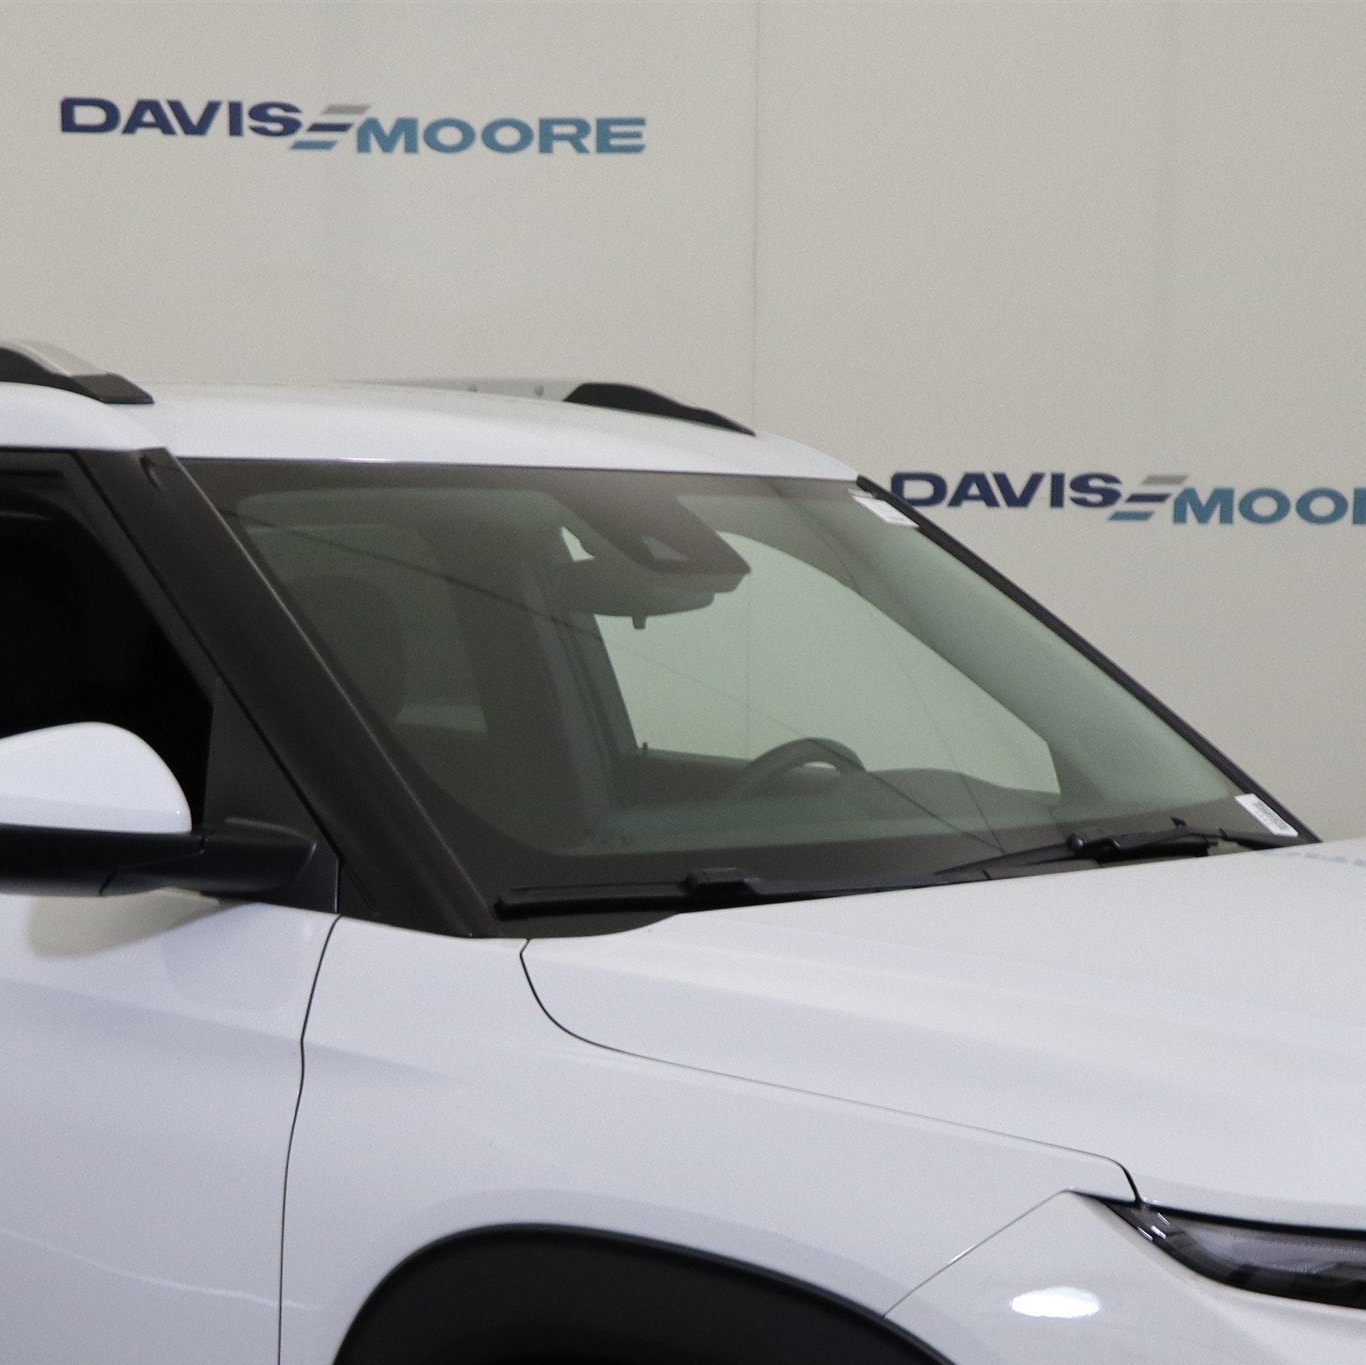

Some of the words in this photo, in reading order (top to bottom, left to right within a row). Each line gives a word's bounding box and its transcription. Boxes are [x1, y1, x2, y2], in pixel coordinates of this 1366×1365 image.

[59, 96, 303, 138] DAVIS
[356, 117, 647, 154] MOORE
[891, 472, 1122, 509] DAVIS
